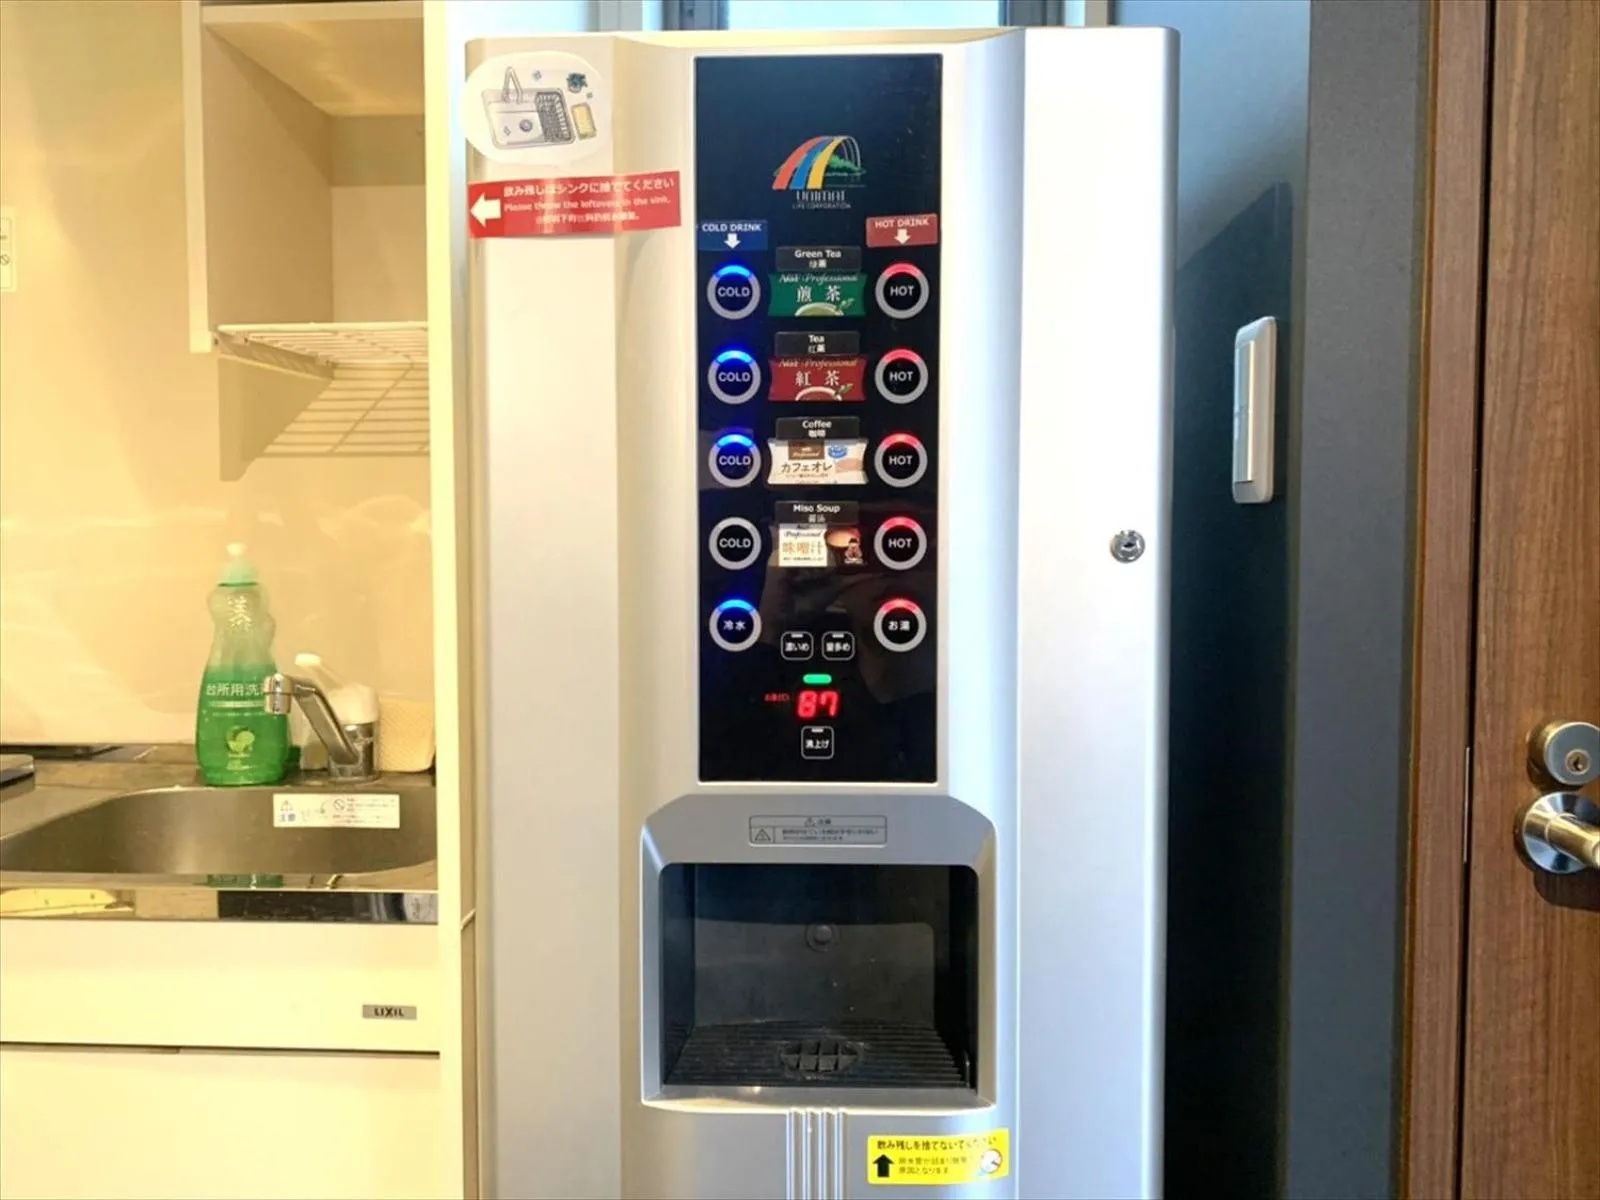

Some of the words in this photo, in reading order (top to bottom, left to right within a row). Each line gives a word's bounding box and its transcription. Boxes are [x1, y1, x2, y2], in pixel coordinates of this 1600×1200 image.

[702, 223, 728, 232] COLD
[730, 223, 762, 232] DRINK
[875, 219, 895, 228] HOT
[897, 218, 929, 227] DRINK
[794, 249, 823, 258] Green
[826, 249, 841, 258] Tea
[718, 287, 751, 298] COLD
[890, 286, 914, 296] HOT
[808, 334, 825, 343] Tea
[718, 371, 750, 382] COLD
[889, 371, 914, 381] HOT
[802, 420, 832, 428] Coffee
[719, 455, 751, 465] COLD
[889, 454, 913, 465] HOT
[781, 461, 832, 473] カフェオレ
[793, 504, 814, 512] Miso
[817, 504, 840, 513] Soup
[719, 537, 751, 548] COLD
[888, 537, 912, 547] HOT
[723, 619, 746, 631] 冷水
[888, 619, 911, 631] お湯
[798, 690, 839, 718] 87
[374, 1007, 404, 1017] LIXIL
